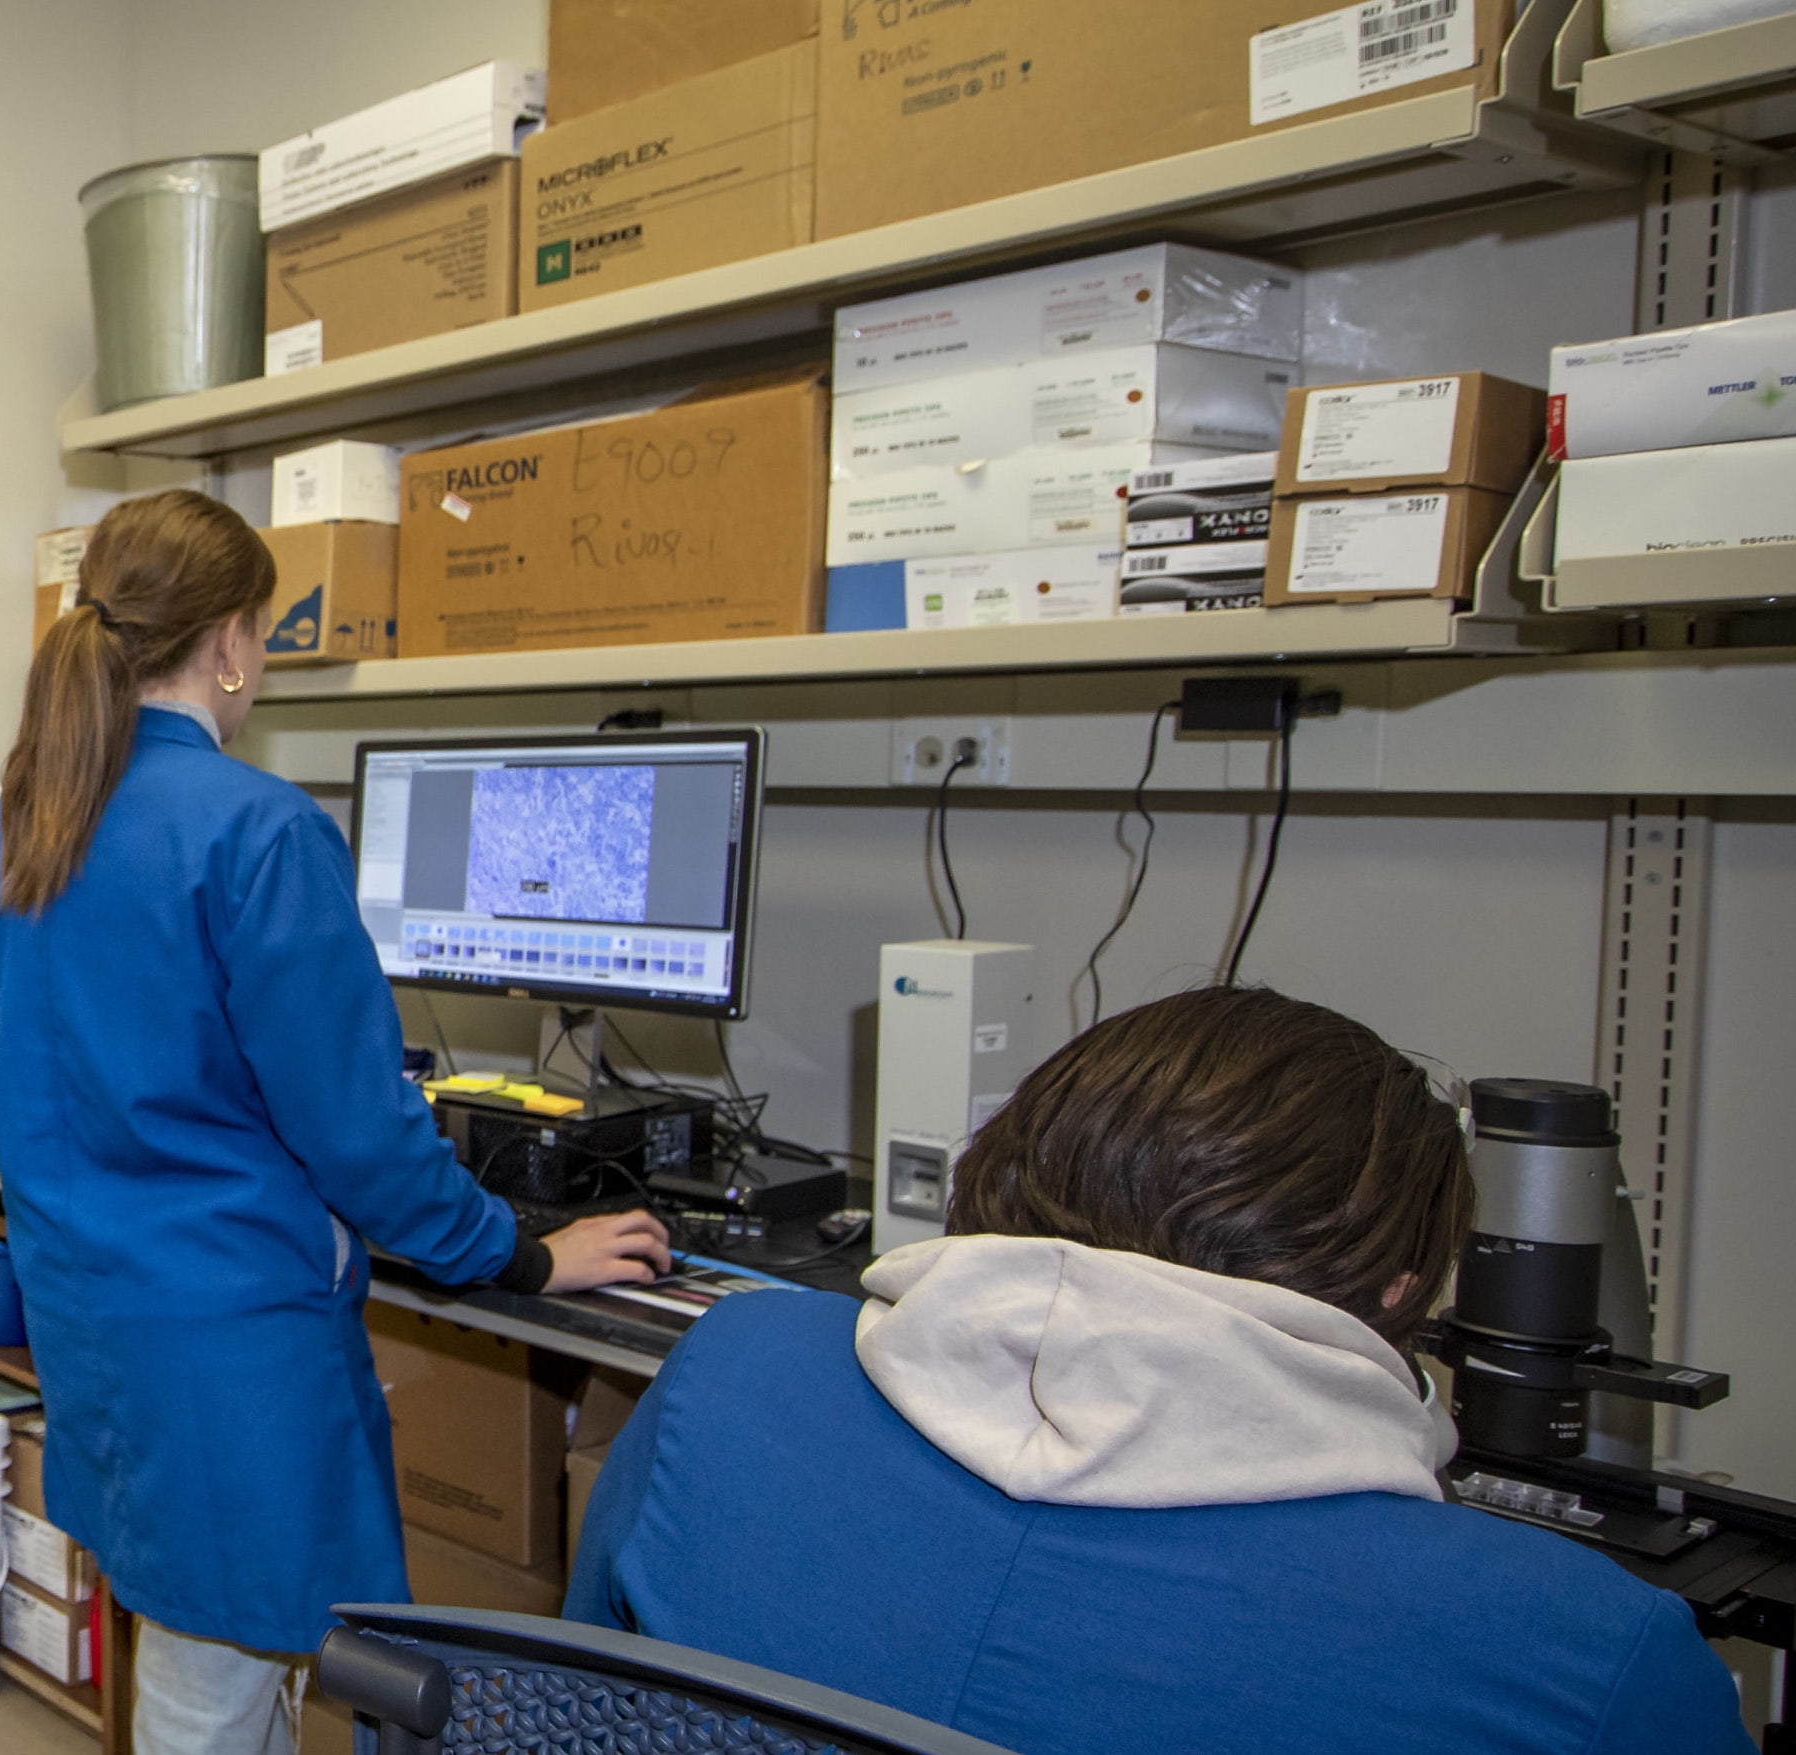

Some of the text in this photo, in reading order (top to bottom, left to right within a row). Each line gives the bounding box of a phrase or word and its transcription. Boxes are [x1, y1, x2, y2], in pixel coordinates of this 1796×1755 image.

[537, 141, 667, 194] MICROFLEX
[537, 189, 592, 222] ONYX
[1418, 380, 1451, 397] 3917
[1708, 380, 1757, 397] METTLER
[446, 455, 538, 492] FALCON
[1407, 498, 1440, 512] 3917
[1199, 508, 1269, 528] ONYX
